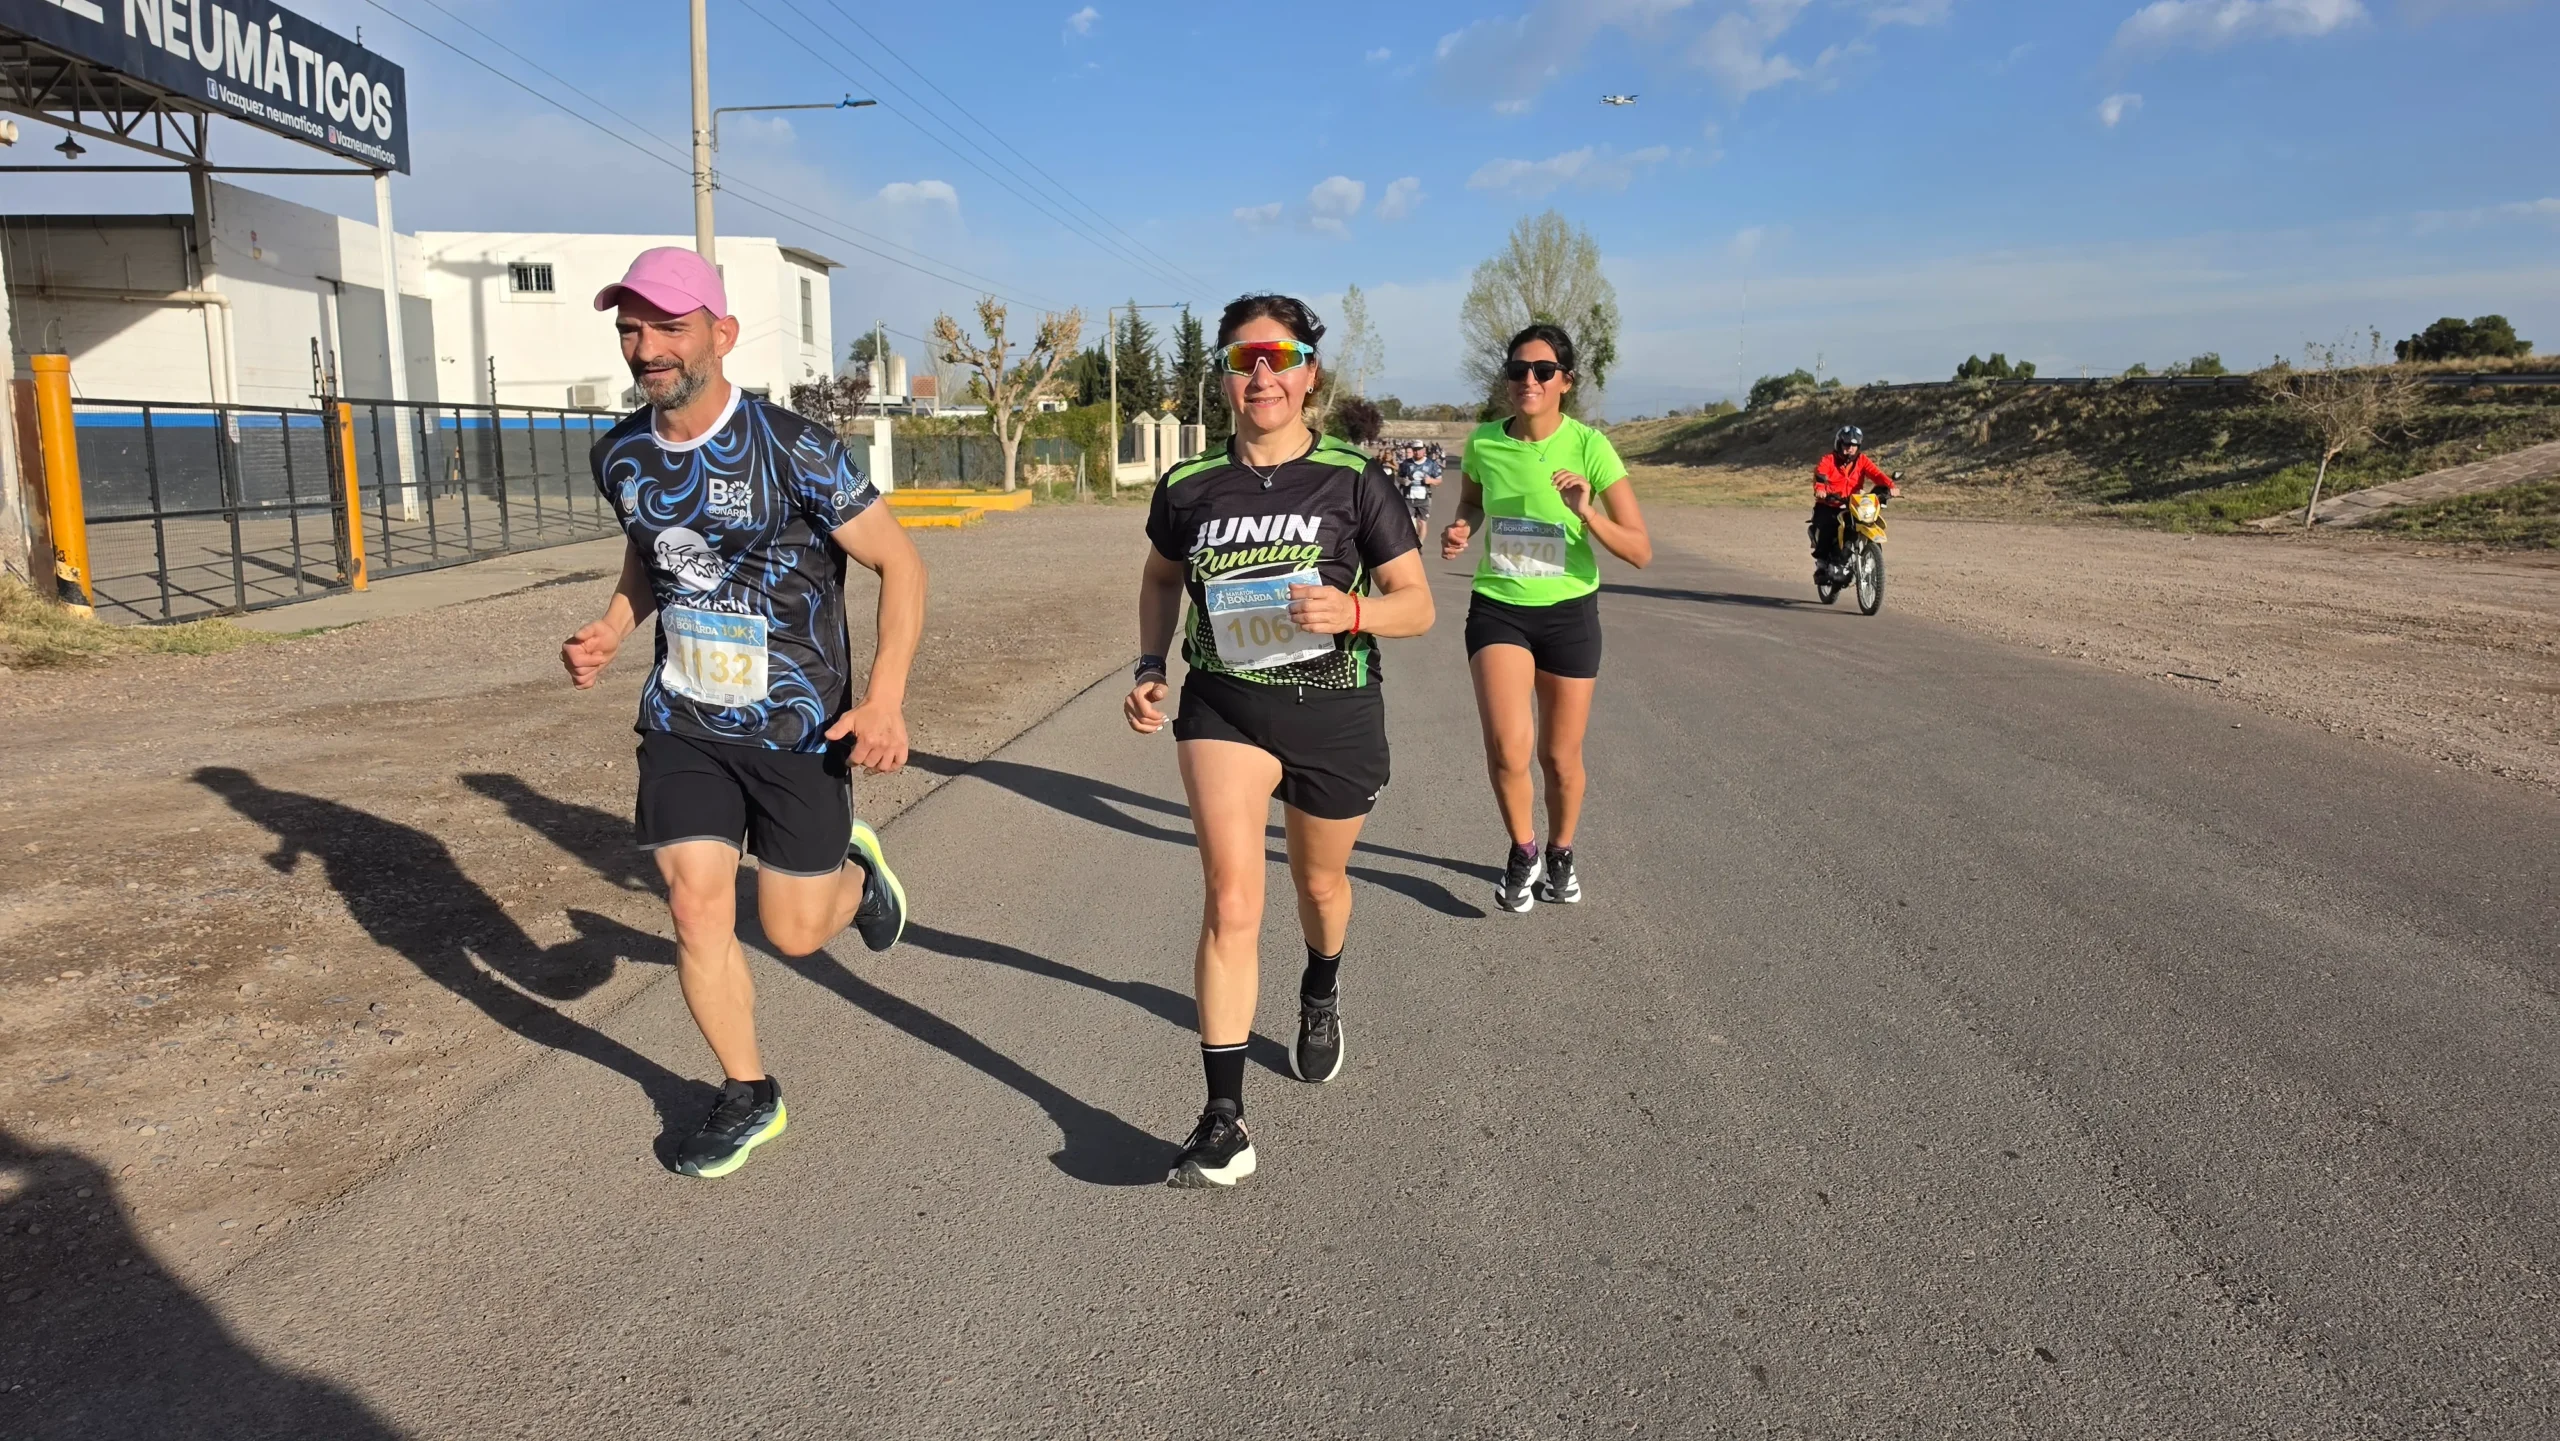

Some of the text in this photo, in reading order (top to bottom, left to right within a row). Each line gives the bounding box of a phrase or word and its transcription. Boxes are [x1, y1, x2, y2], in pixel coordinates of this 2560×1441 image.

[124, 0, 392, 141] NEUMÁTICOS
[219, 84, 324, 139] Vazquez neumaticos
[336, 129, 396, 165] Vazneumaticos
[708, 507, 753, 519] BONARDA
[1189, 538, 1323, 582] Running
[1227, 593, 1274, 605] BONARDA
[1227, 613, 1312, 649] 106
